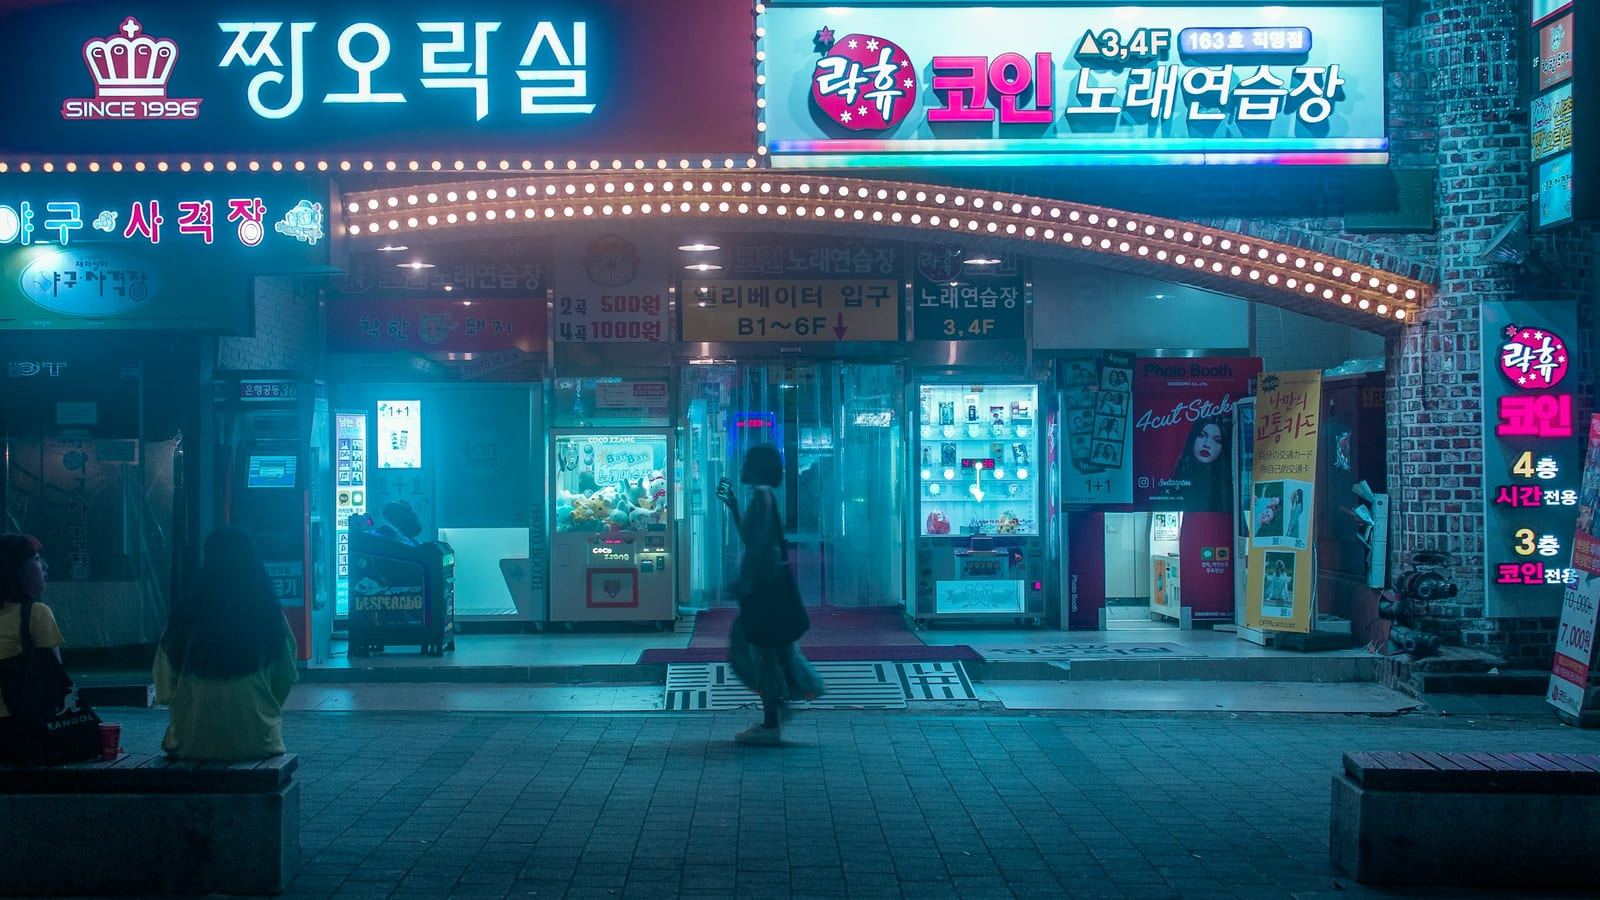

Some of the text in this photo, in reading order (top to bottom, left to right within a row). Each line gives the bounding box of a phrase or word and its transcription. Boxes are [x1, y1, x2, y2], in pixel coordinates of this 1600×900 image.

[1189, 30, 1303, 50] 163호 직영점
[93, 46, 170, 58] COCO
[816, 47, 903, 121] 락휴
[927, 52, 1053, 123] 코인
[1066, 64, 1345, 123] 노래연습장
[65, 101, 198, 117] SINCE 1996
[0, 198, 267, 246] 야구 사격장
[787, 247, 897, 274] 노래연습장
[560, 294, 662, 317] 2곡 500원
[694, 285, 891, 309] 엘리베이터 입구
[919, 286, 1019, 309] 노래연습장
[560, 320, 662, 342] 4곡 1000원
[738, 317, 828, 336] B1~6F
[943, 318, 996, 338] 3,4F
[1144, 363, 1233, 378] Photo Booth
[1503, 337, 1559, 383] 락휴
[389, 406, 410, 417] 1+1
[1136, 405, 1188, 432] 4cut
[1498, 394, 1572, 437] 코인
[1256, 412, 1317, 443] 교통카드
[1513, 451, 1559, 479] 4층
[1085, 479, 1112, 493] 1+1
[1157, 478, 1192, 490] Instagram
[1496, 486, 1578, 507] 시간 전용
[1514, 528, 1561, 556] 3층
[1497, 562, 1579, 584] 코인 전용
[355, 596, 423, 611] DESPERADO
[47, 714, 95, 729] KANGOL
